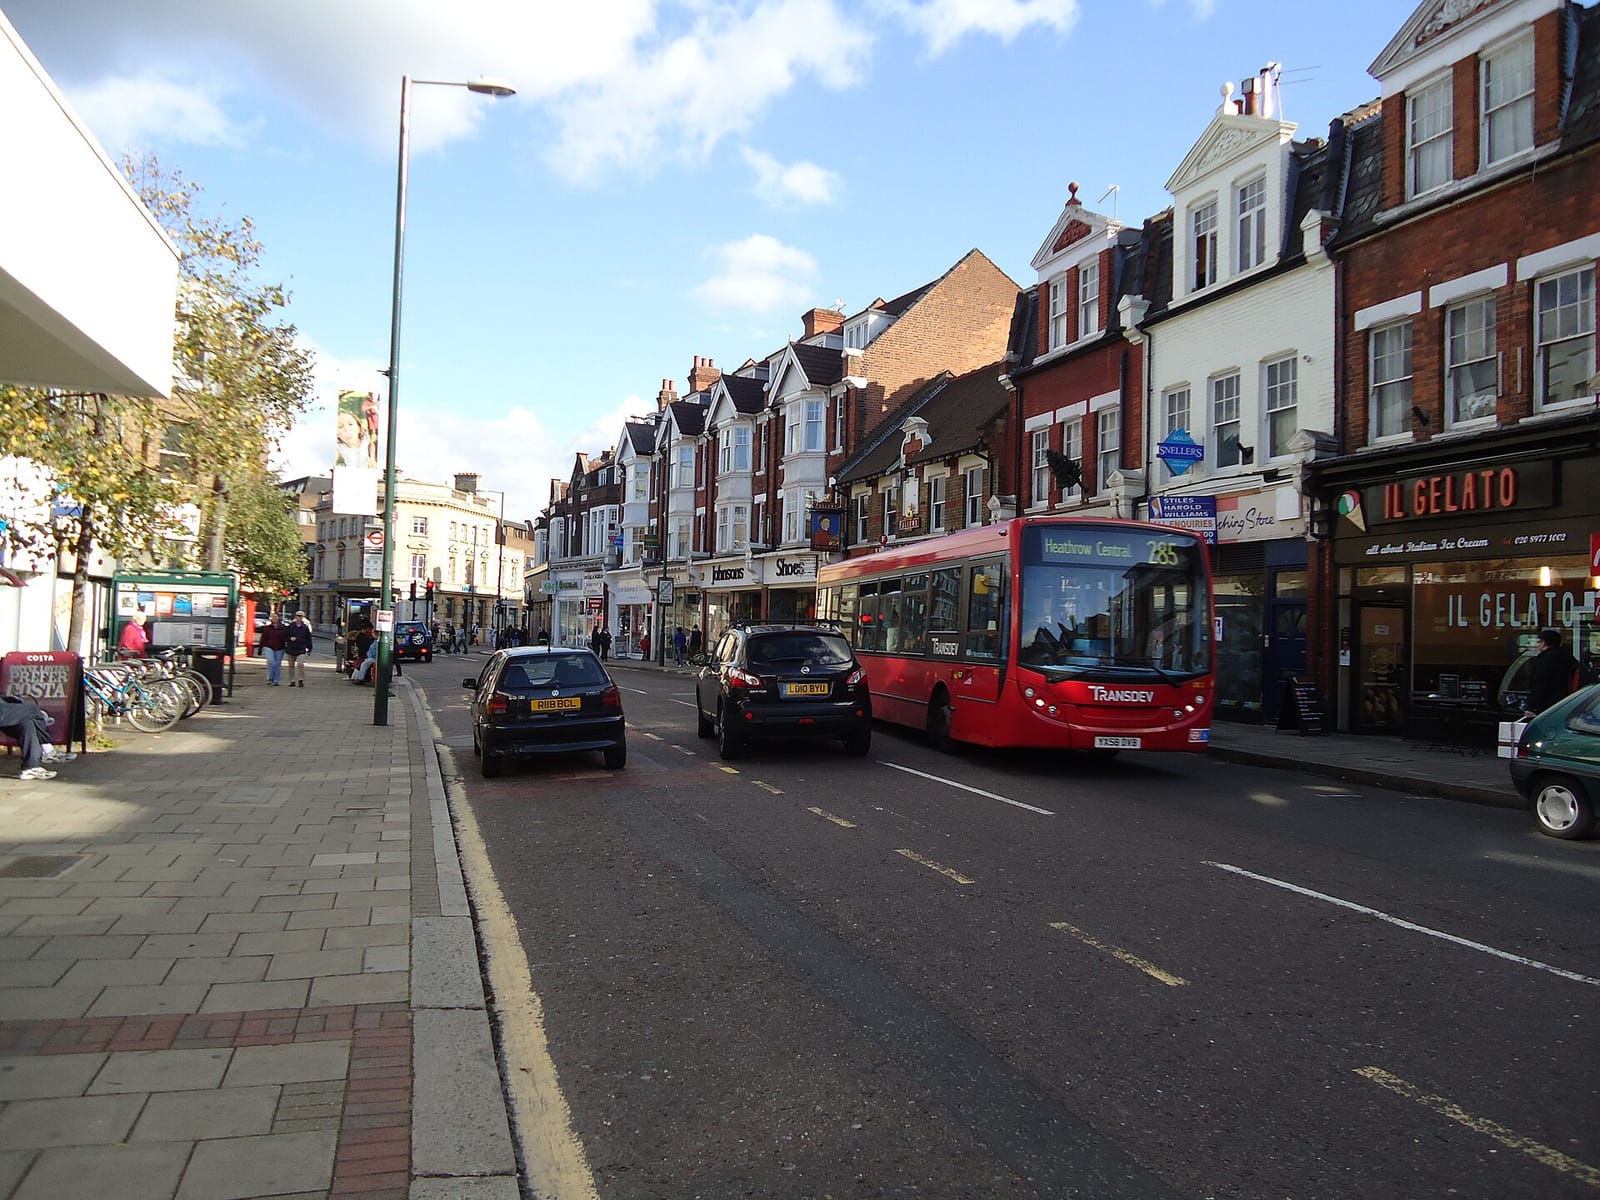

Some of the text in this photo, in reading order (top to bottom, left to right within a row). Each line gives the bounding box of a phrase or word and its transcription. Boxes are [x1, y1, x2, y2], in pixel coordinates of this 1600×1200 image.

[1160, 446, 1202, 457] SNELLERS
[1384, 468, 1515, 519] IL GELATO
[1170, 520, 1214, 528] ENQUIRIES
[1439, 539, 1456, 549] Ice
[1457, 537, 1489, 548] Cream
[1045, 538, 1178, 565] Heathrow Central 285
[711, 565, 744, 585] Johnsons
[1449, 594, 1468, 627] IL
[1480, 591, 1574, 627] GELATO
[9, 671, 68, 682] PREFER
[6, 682, 68, 698] COSTA
